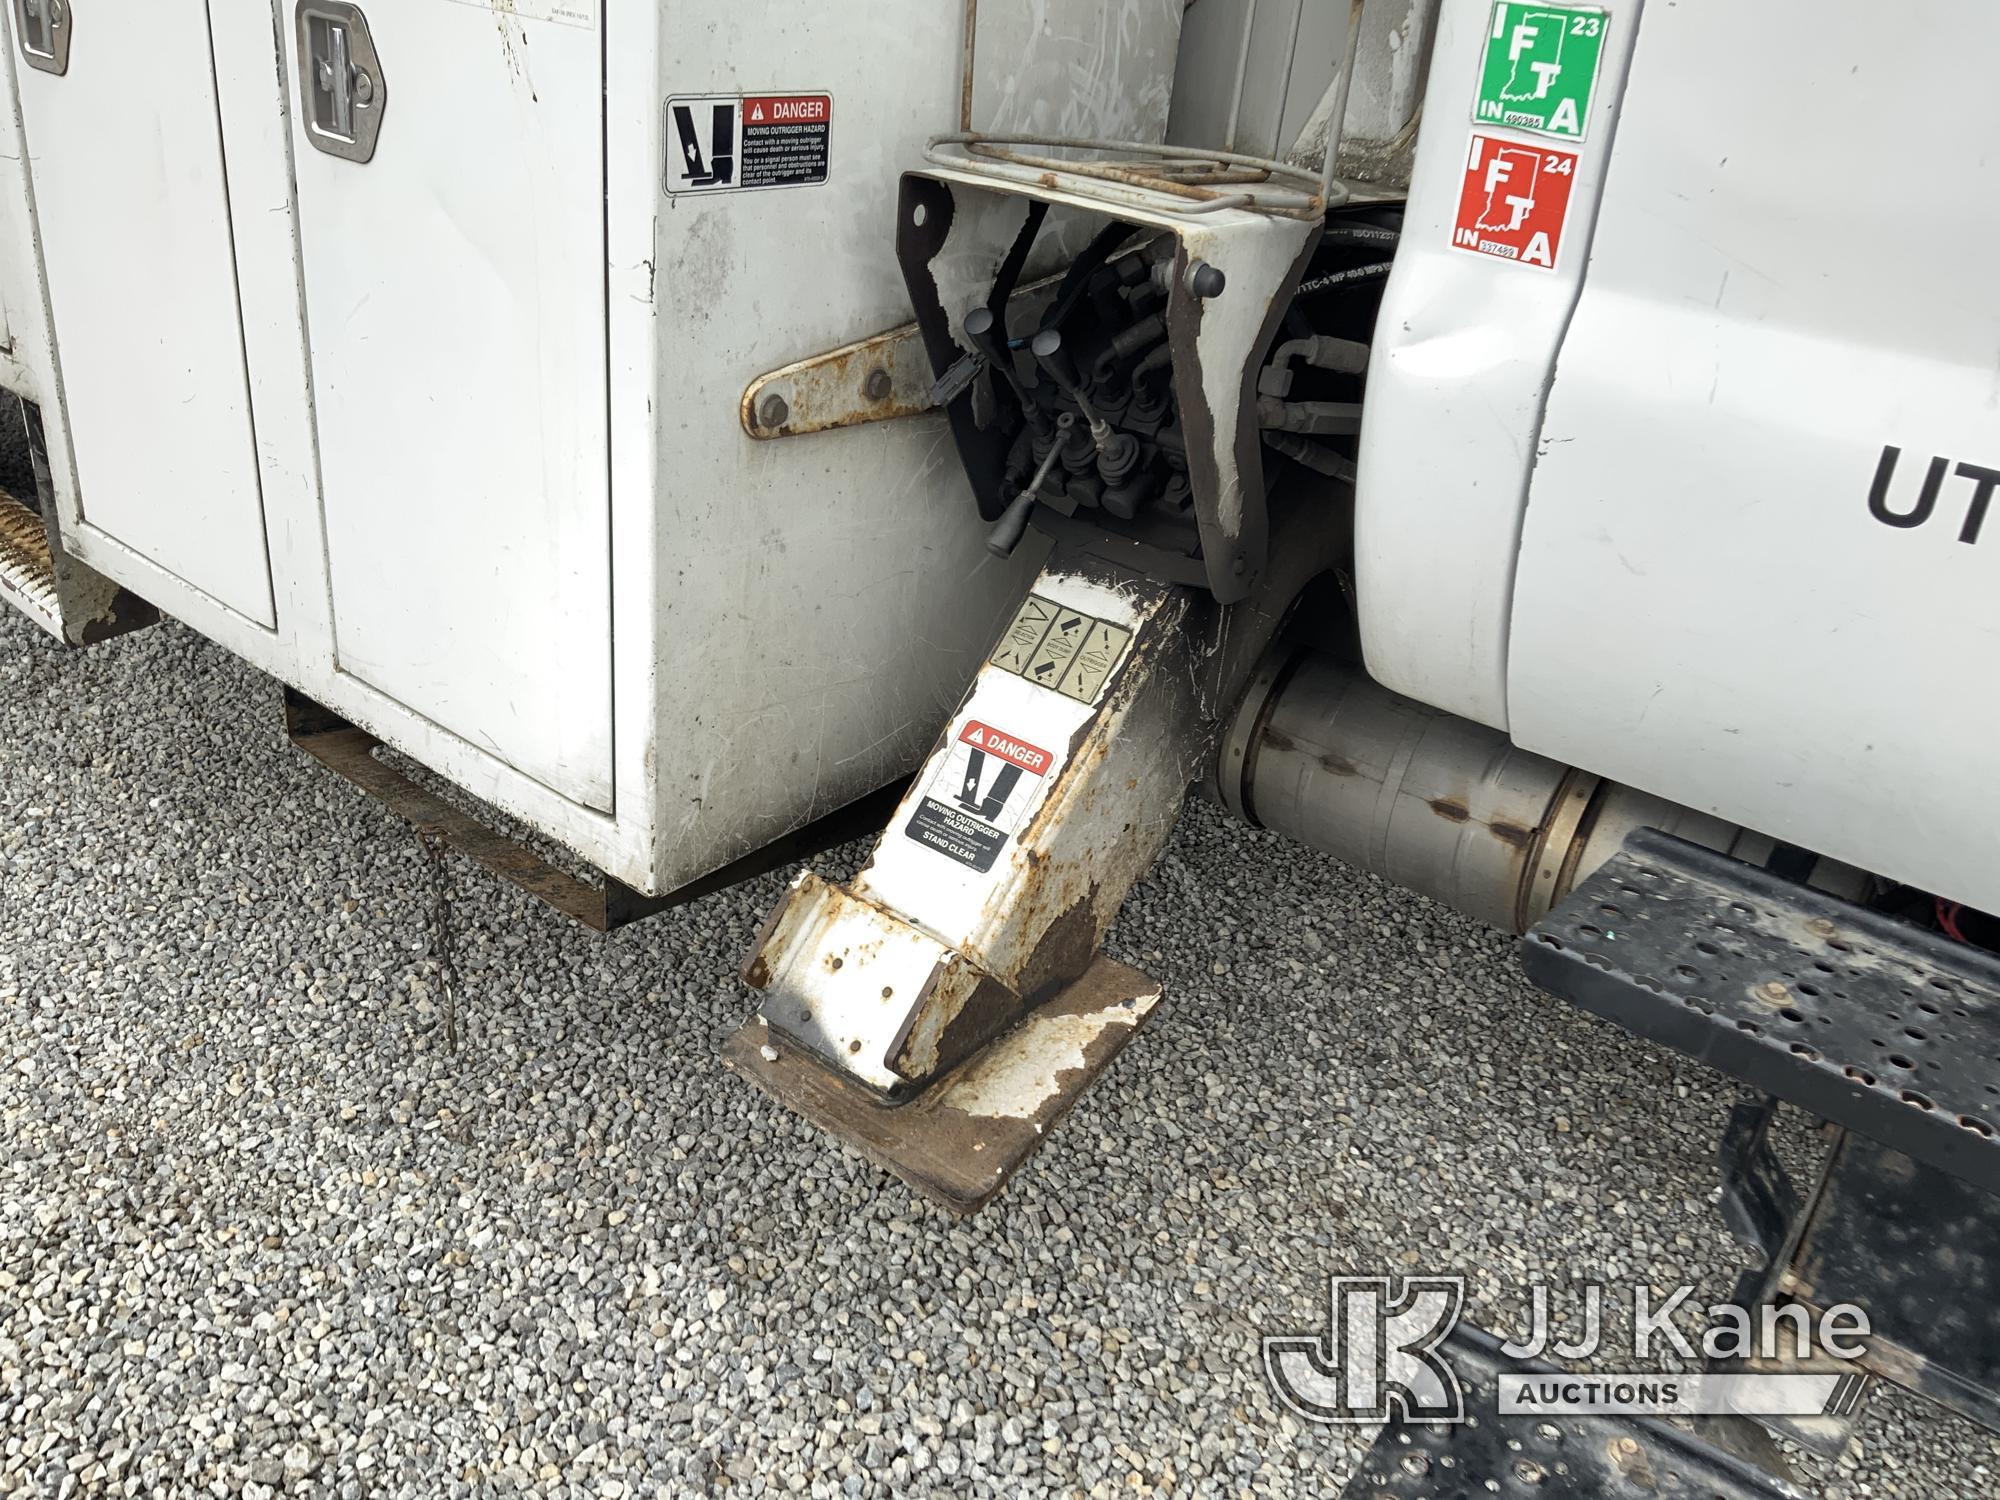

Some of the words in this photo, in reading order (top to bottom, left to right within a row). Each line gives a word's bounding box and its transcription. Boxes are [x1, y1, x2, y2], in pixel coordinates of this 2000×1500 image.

[1570, 16, 1599, 36] 23
[773, 102, 823, 118] DANGER
[1480, 100, 1503, 119] IN
[771, 126, 803, 134] OUTRIGGER
[804, 125, 825, 133] HAZARD
[1543, 156, 1572, 176] 24
[1456, 228, 1478, 247] IN
[987, 734, 1044, 768] DANGER
[926, 800, 956, 819] MOVING
[956, 815, 999, 839] OUTRIGGER
[943, 816, 975, 836] HAZARD
[922, 830, 949, 848] STAND
[948, 843, 976, 862] CLEAR
